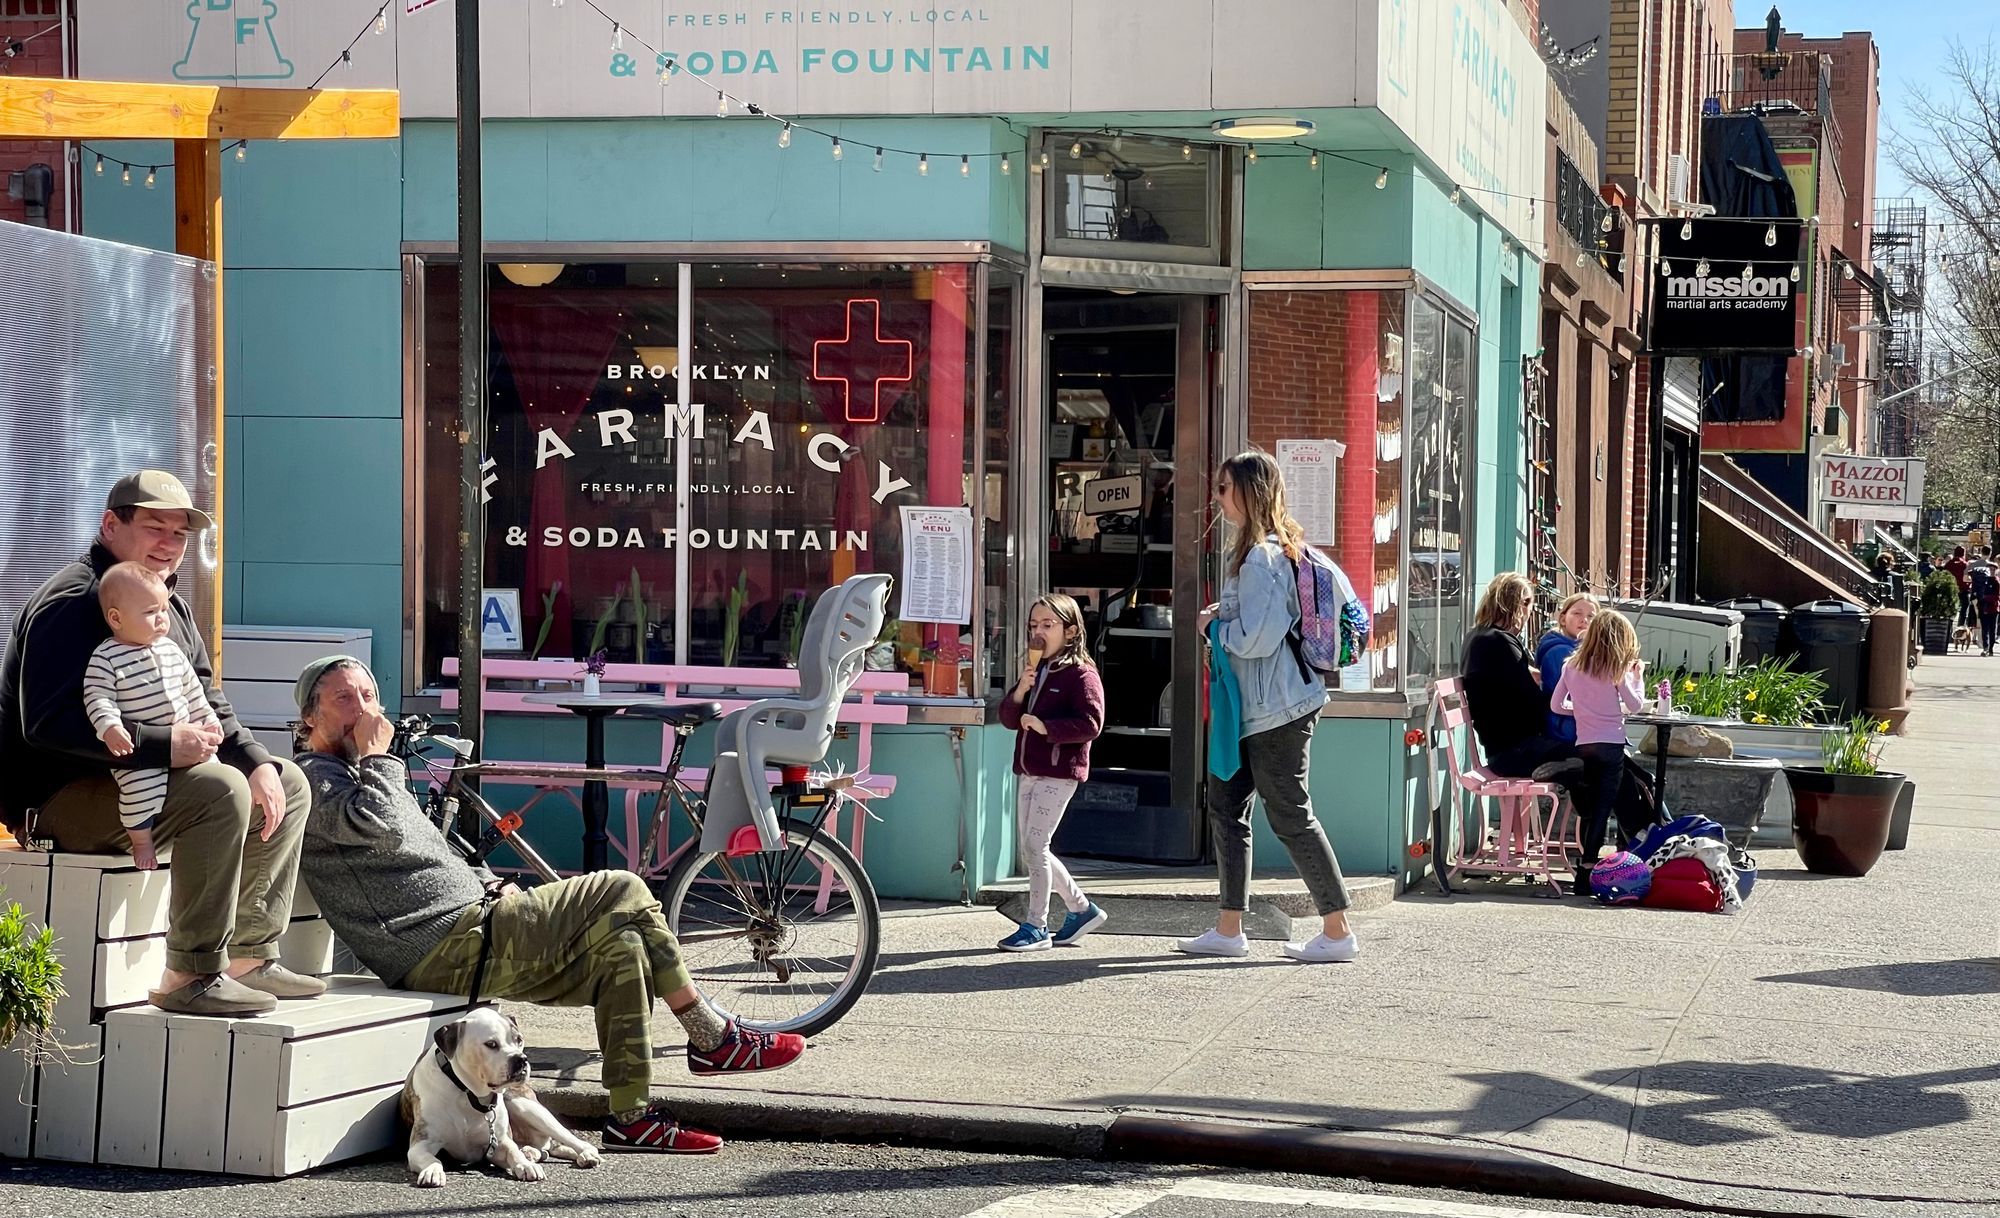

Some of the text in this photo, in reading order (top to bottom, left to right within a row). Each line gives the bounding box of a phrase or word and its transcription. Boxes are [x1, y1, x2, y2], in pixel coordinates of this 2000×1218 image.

[235, 17, 260, 45] F
[668, 13, 746, 27] FRESH
[609, 45, 1050, 78] & SODA FOUNTAIN
[1667, 276, 1789, 297] mission
[1667, 299, 1788, 311] martial arts academy
[1097, 486, 1130, 502] OPEN
[1830, 479, 1903, 501] BAKER
[505, 526, 868, 551] & SODA FOUNTAIN
[483, 596, 512, 633] A
